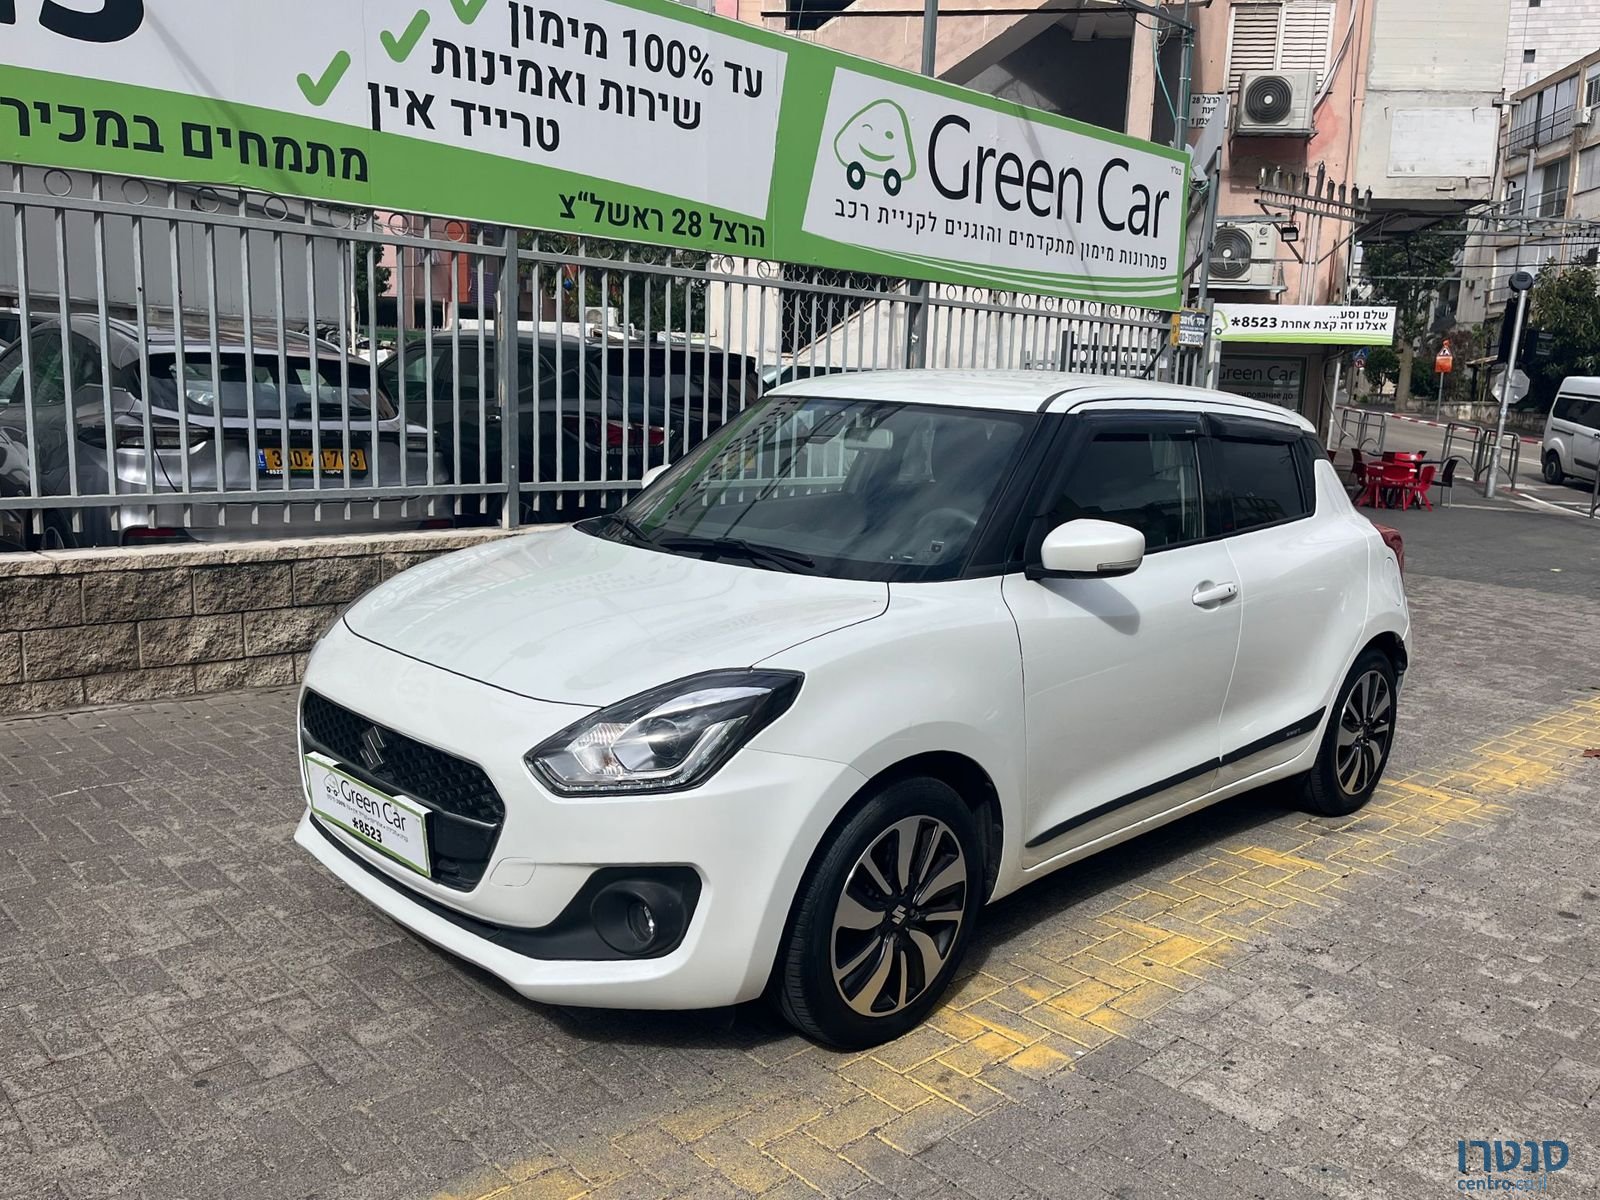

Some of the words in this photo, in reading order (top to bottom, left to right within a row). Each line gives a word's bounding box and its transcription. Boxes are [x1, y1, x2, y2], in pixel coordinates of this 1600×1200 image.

[509, 1, 608, 60] מימון
[623, 30, 713, 85] 100%
[432, 39, 586, 107] ואמינות
[725, 61, 762, 97] עד
[368, 82, 435, 132] אין
[599, 79, 700, 129] שירות
[451, 99, 560, 151] טרייד
[182, 122, 368, 182] מתמחים
[928, 115, 1084, 223] Green
[1098, 158, 1170, 238] Car
[672, 209, 702, 237] 28
[835, 199, 869, 222] רכב
[877, 207, 937, 235] לקניית
[709, 213, 765, 247] הרצל
[945, 219, 1002, 244] והוגנים
[1009, 231, 1074, 256] מתקדמים
[1081, 243, 1113, 262] מימון
[1118, 250, 1167, 270] פתרונות
[1280, 320, 1310, 329] אחרת
[1313, 321, 1337, 332] קצת
[1340, 322, 1353, 330] זה
[1356, 321, 1387, 331] אצלנו
[1363, 310, 1388, 320] שלם
[1266, 365, 1296, 381] Car
[341, 780, 381, 818] Green
[382, 802, 407, 832] Car
